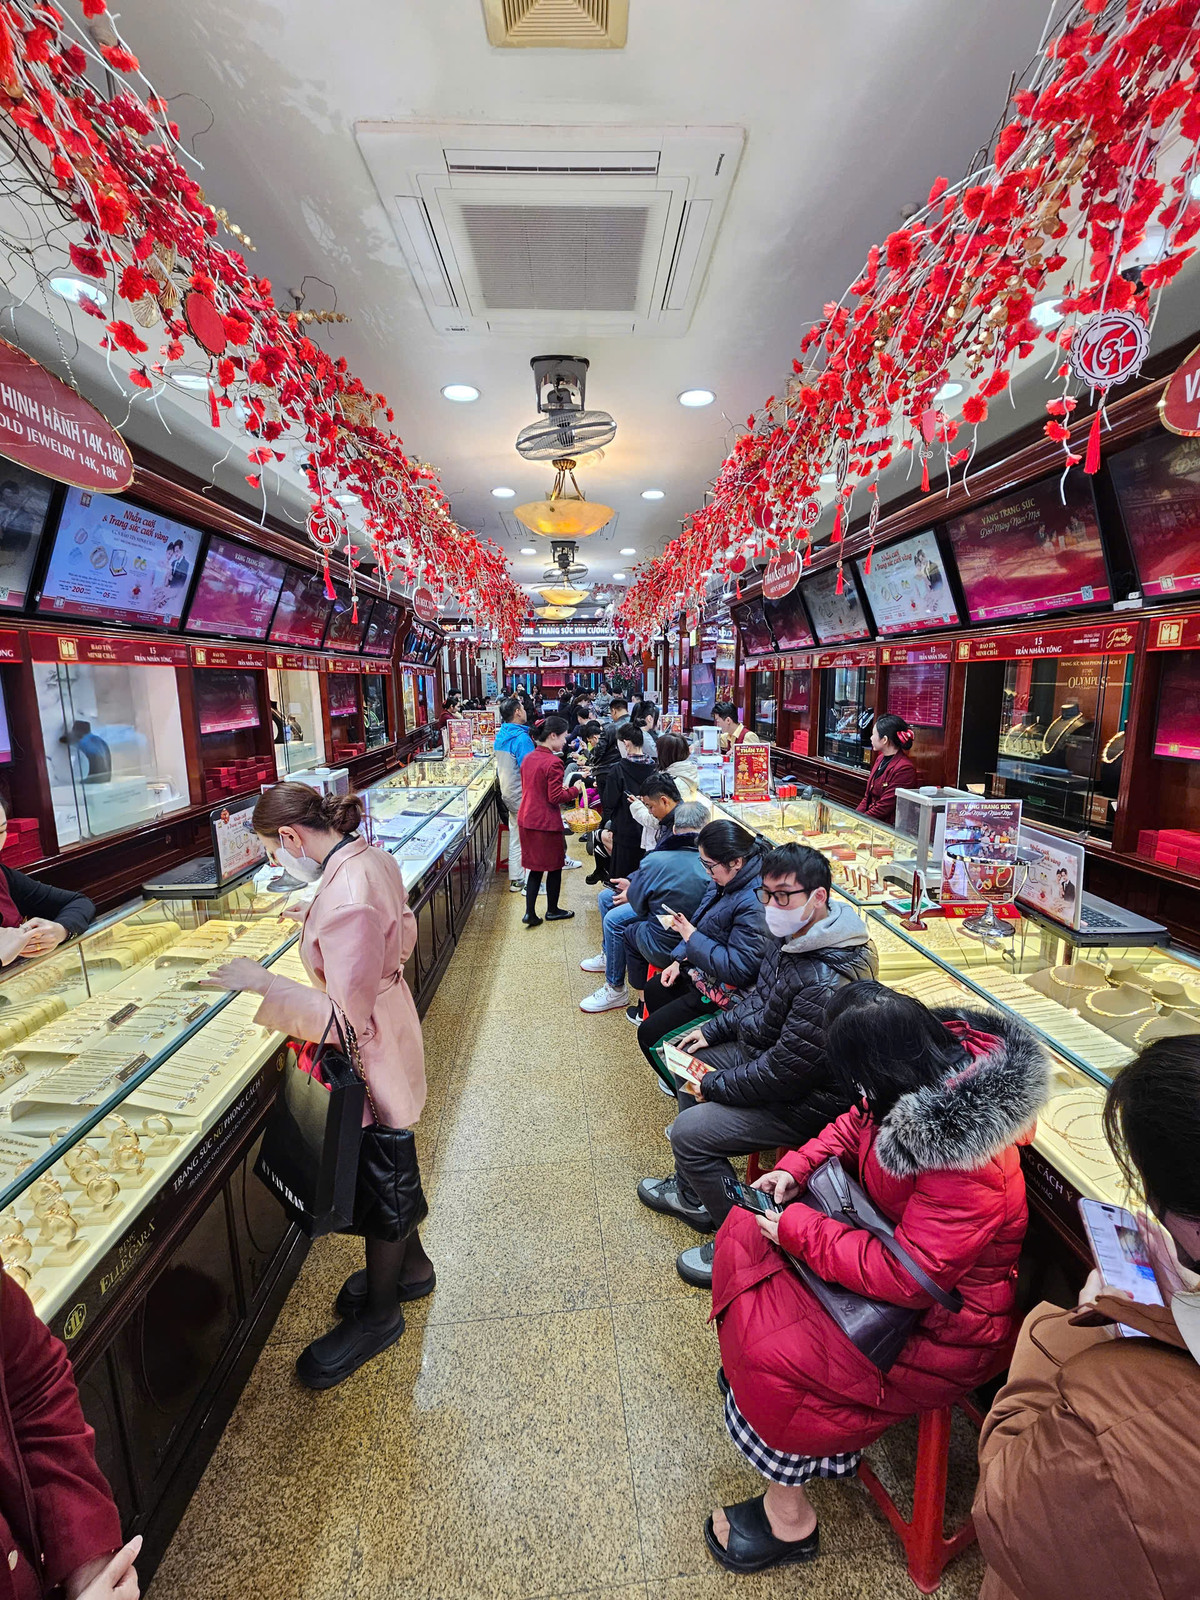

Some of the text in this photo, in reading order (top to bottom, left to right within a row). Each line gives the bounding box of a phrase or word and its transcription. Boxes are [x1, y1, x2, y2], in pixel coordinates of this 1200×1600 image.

[42, 404, 80, 443] HÀNH
[27, 426, 75, 461] JEWELRY
[101, 464, 118, 481] 18K
[999, 505, 1021, 519] TRANG
[1021, 498, 1036, 511] SỨC
[109, 515, 128, 531] Trang
[539, 627, 560, 635] TRANG
[561, 626, 573, 635] SỨC
[574, 627, 586, 635] KIM
[1035, 637, 1043, 645] 15
[1029, 646, 1045, 654] NHÂN
[1046, 645, 1062, 653] TÔNG
[145, 655, 160, 663] NHÂN
[1068, 676, 1107, 689] OLYMPUS
[173, 1156, 199, 1191] TRANG
[199, 1138, 213, 1159] SỨC
[223, 1099, 245, 1129] PHONG
[245, 1079, 261, 1102] CÁCH
[1037, 1163, 1064, 1194] CÁCH
